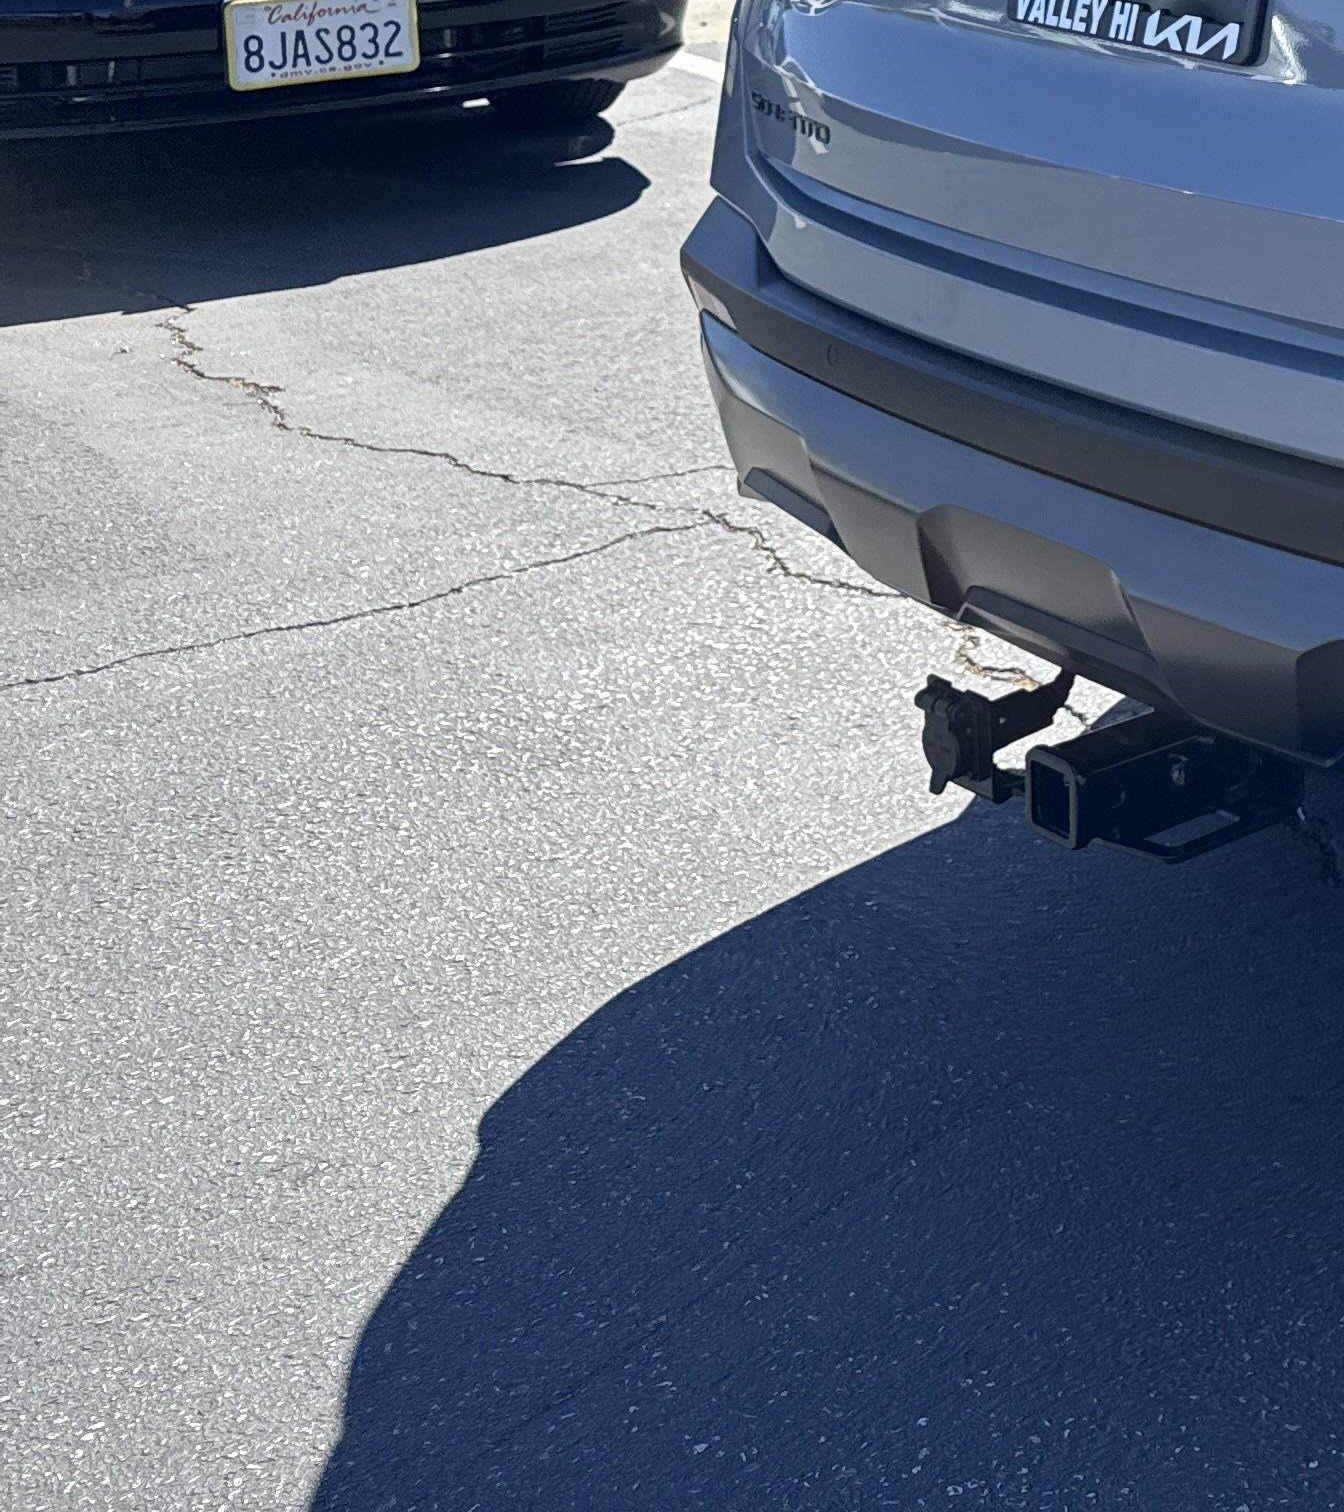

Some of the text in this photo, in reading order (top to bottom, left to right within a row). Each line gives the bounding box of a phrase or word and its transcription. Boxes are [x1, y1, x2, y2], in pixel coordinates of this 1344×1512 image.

[267, 0, 380, 27] California
[1108, 0, 1140, 43] HI
[1143, 9, 1241, 61] KIA
[243, 20, 404, 74] 8JAS832
